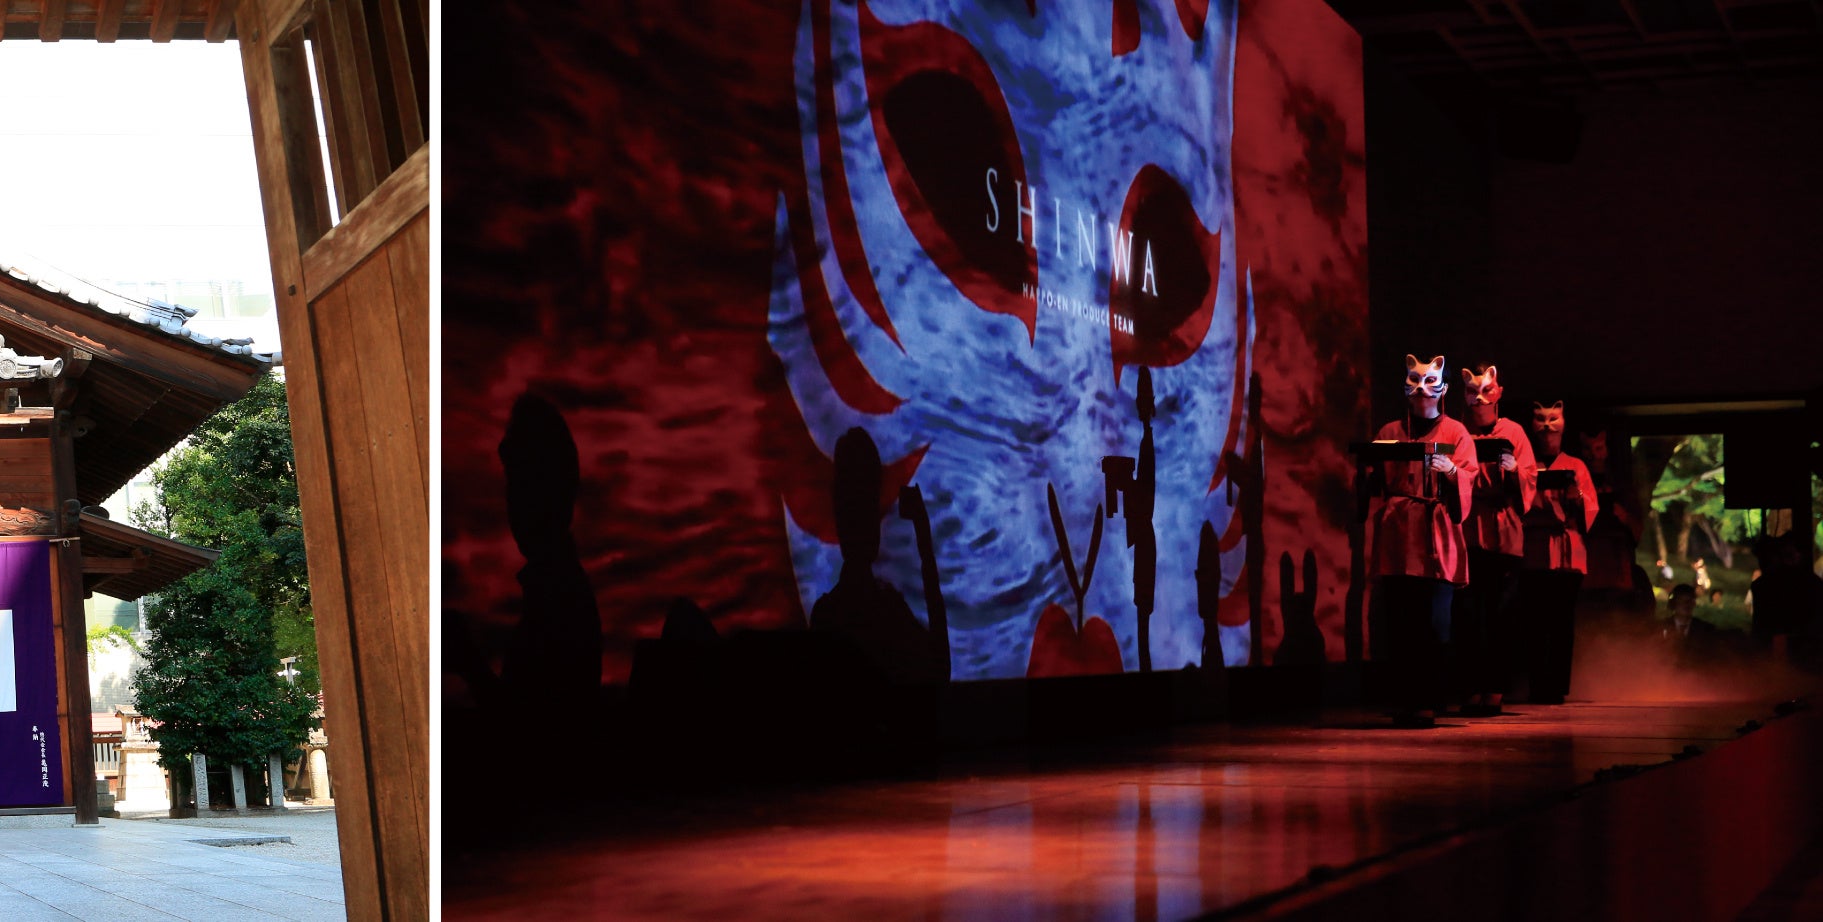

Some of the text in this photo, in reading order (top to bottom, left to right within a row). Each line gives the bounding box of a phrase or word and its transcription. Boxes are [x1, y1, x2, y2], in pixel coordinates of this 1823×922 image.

[986, 167, 1158, 297] SHINWA
[1022, 282, 1134, 335] HAPPO-EN PRODUCE TEAM
